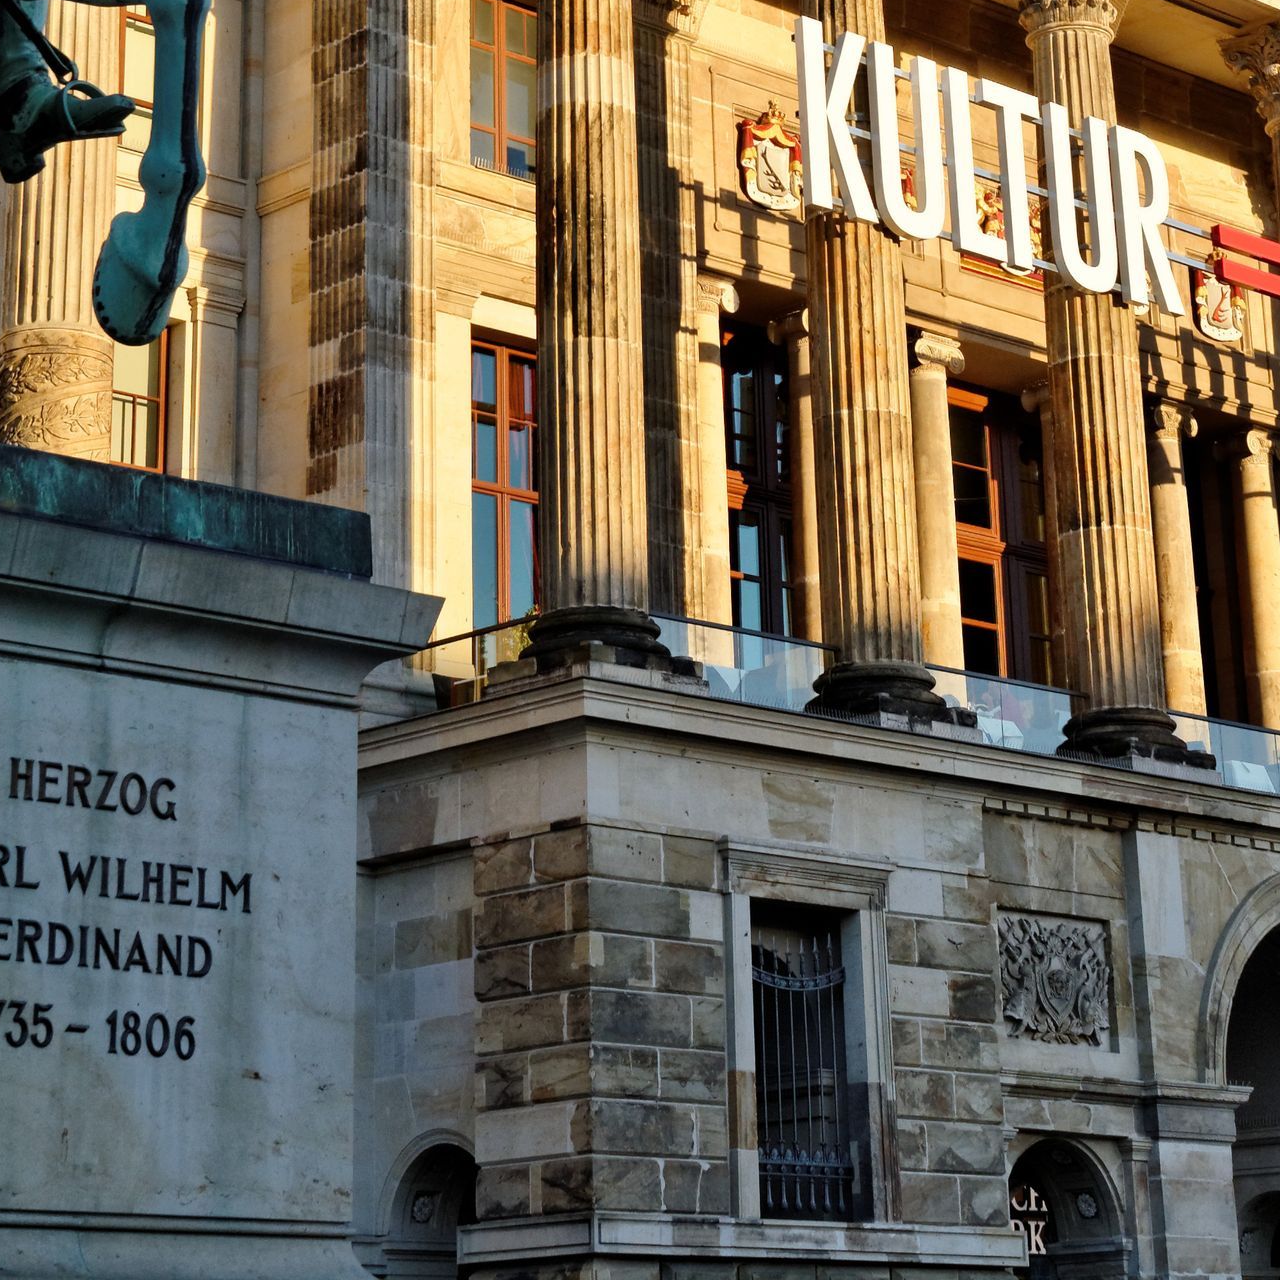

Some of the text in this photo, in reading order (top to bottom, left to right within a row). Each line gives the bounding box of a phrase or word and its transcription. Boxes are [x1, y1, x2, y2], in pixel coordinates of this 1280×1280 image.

[795, 16, 1185, 316] KULTUR
[8, 757, 178, 822] HERZOG
[58, 851, 253, 914] WILHELM
[106, 1009, 196, 1061] 1806
